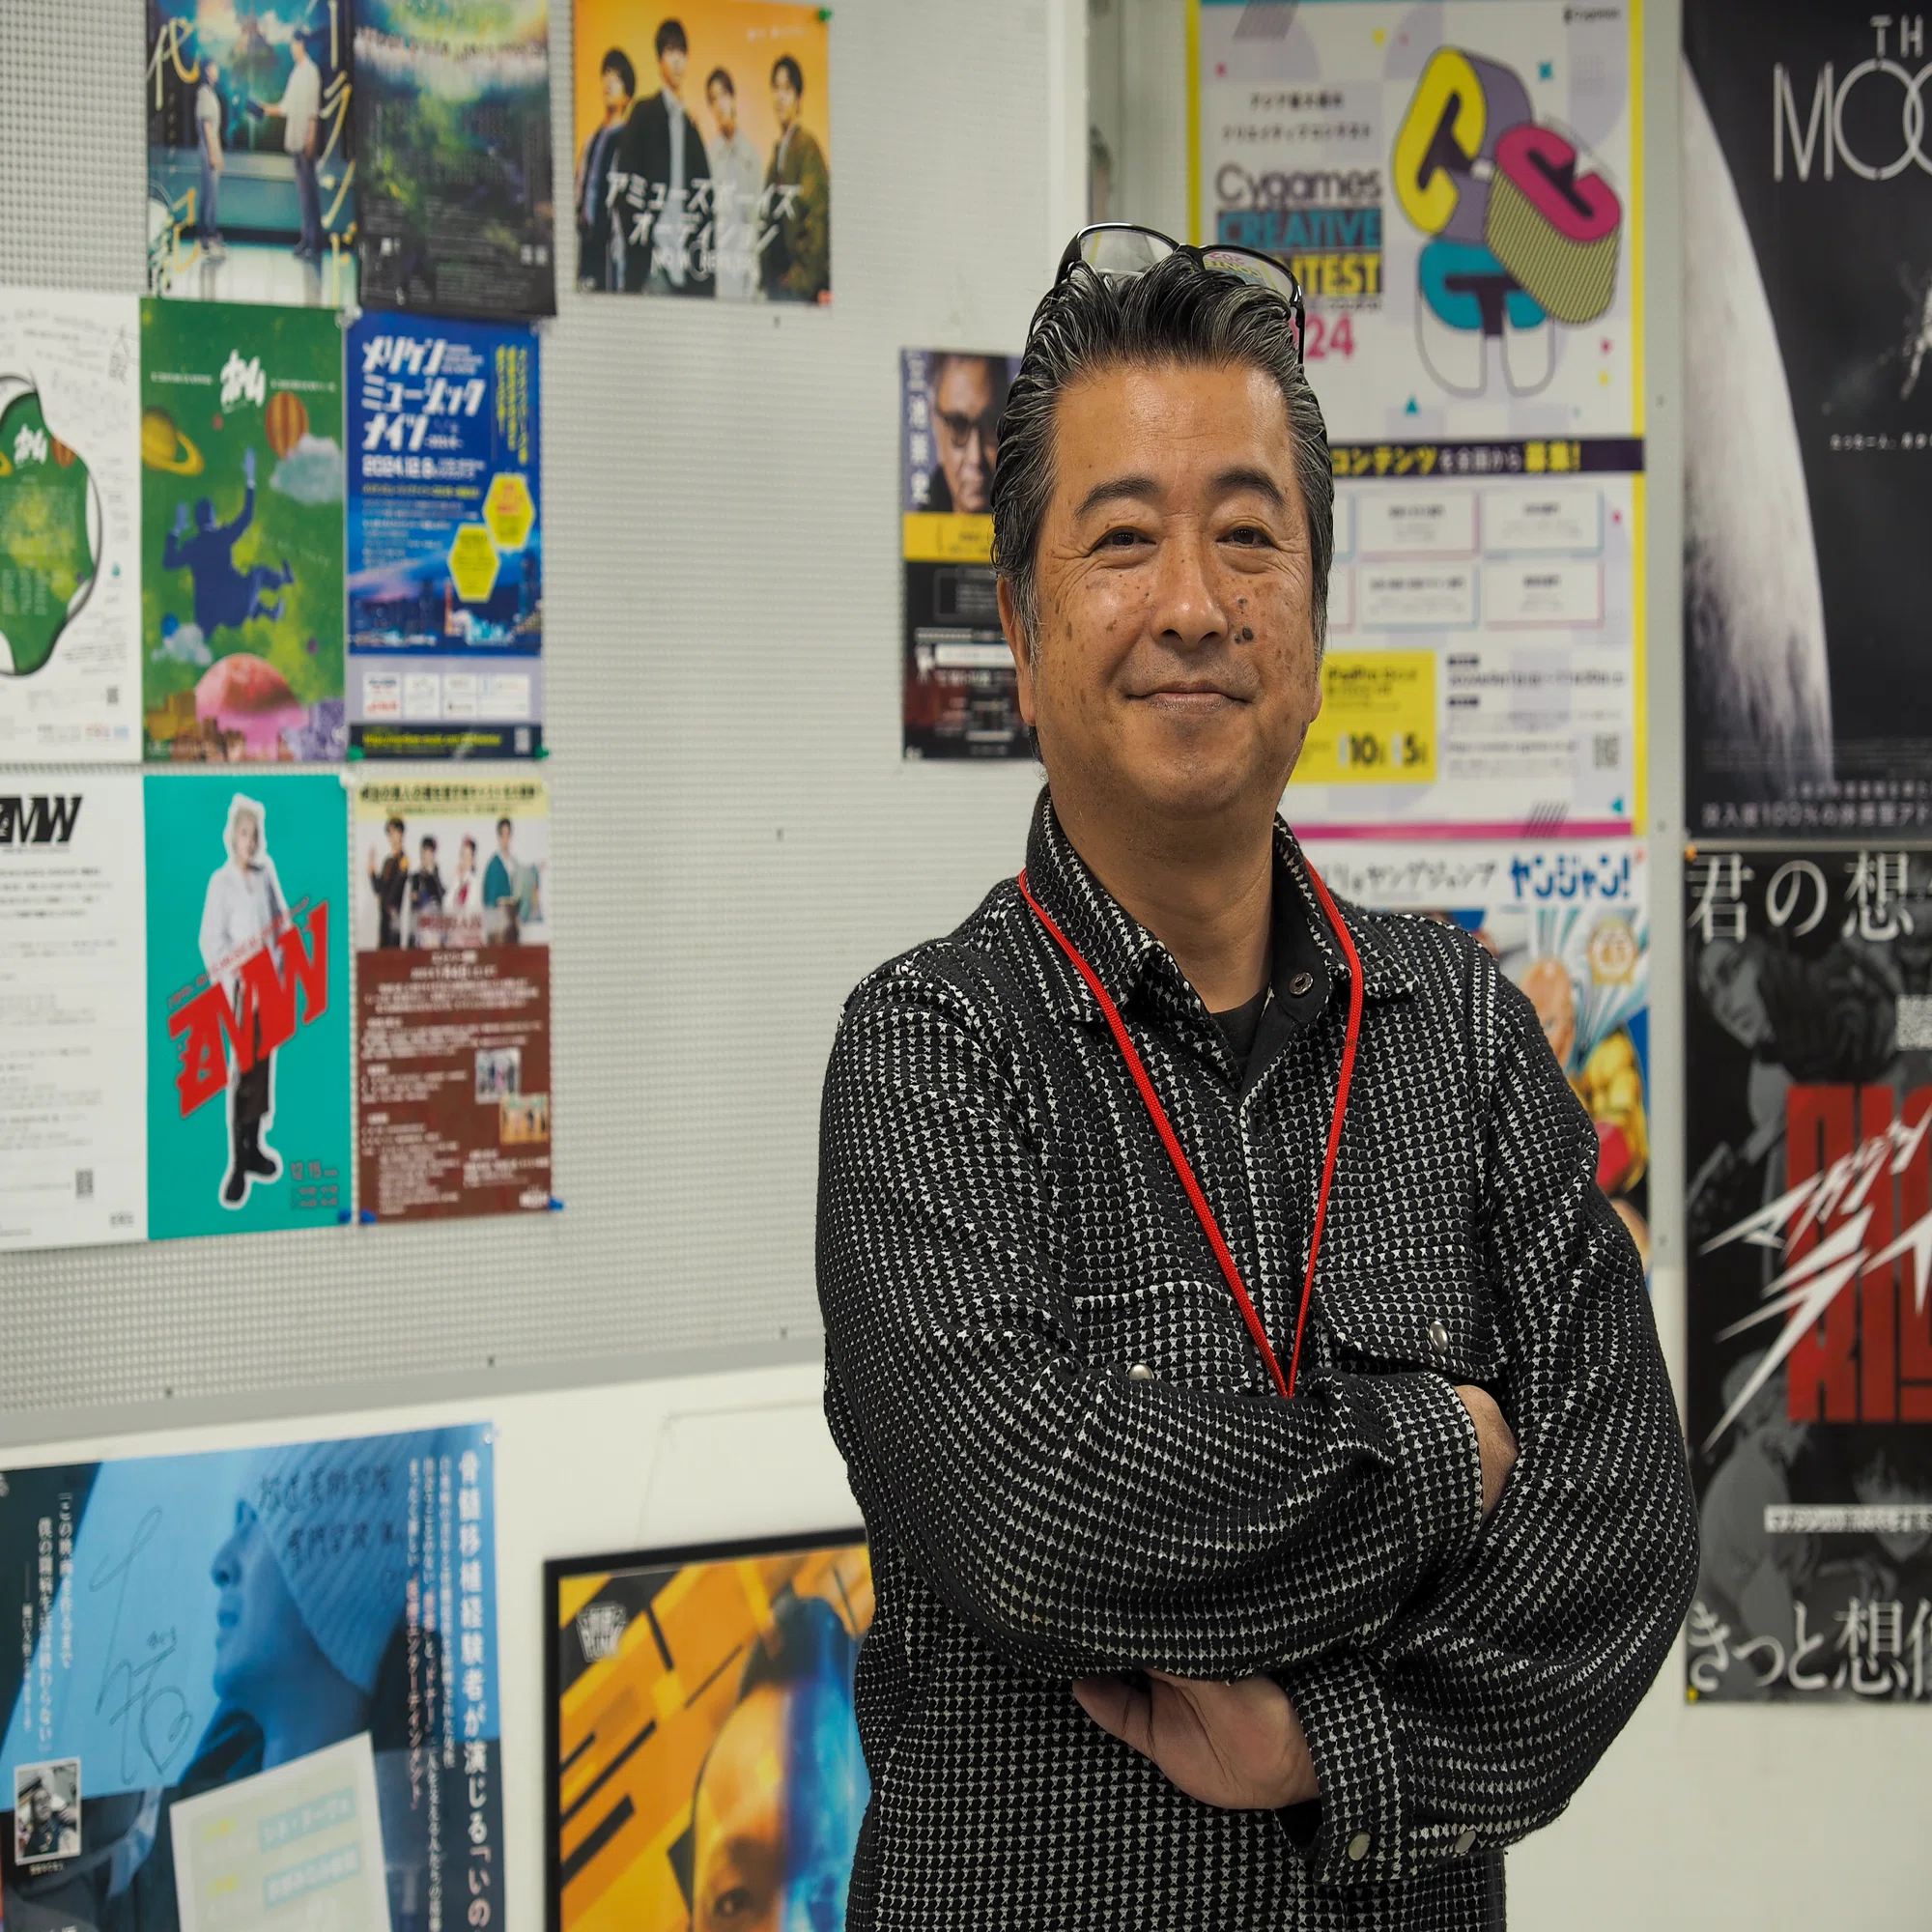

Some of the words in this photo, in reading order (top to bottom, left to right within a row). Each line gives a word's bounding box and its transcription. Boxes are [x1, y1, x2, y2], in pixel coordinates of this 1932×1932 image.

[1215, 161, 1381, 213] Cygames
[1291, 315, 1354, 359] 24
[1687, 850, 1917, 944] 君の想
